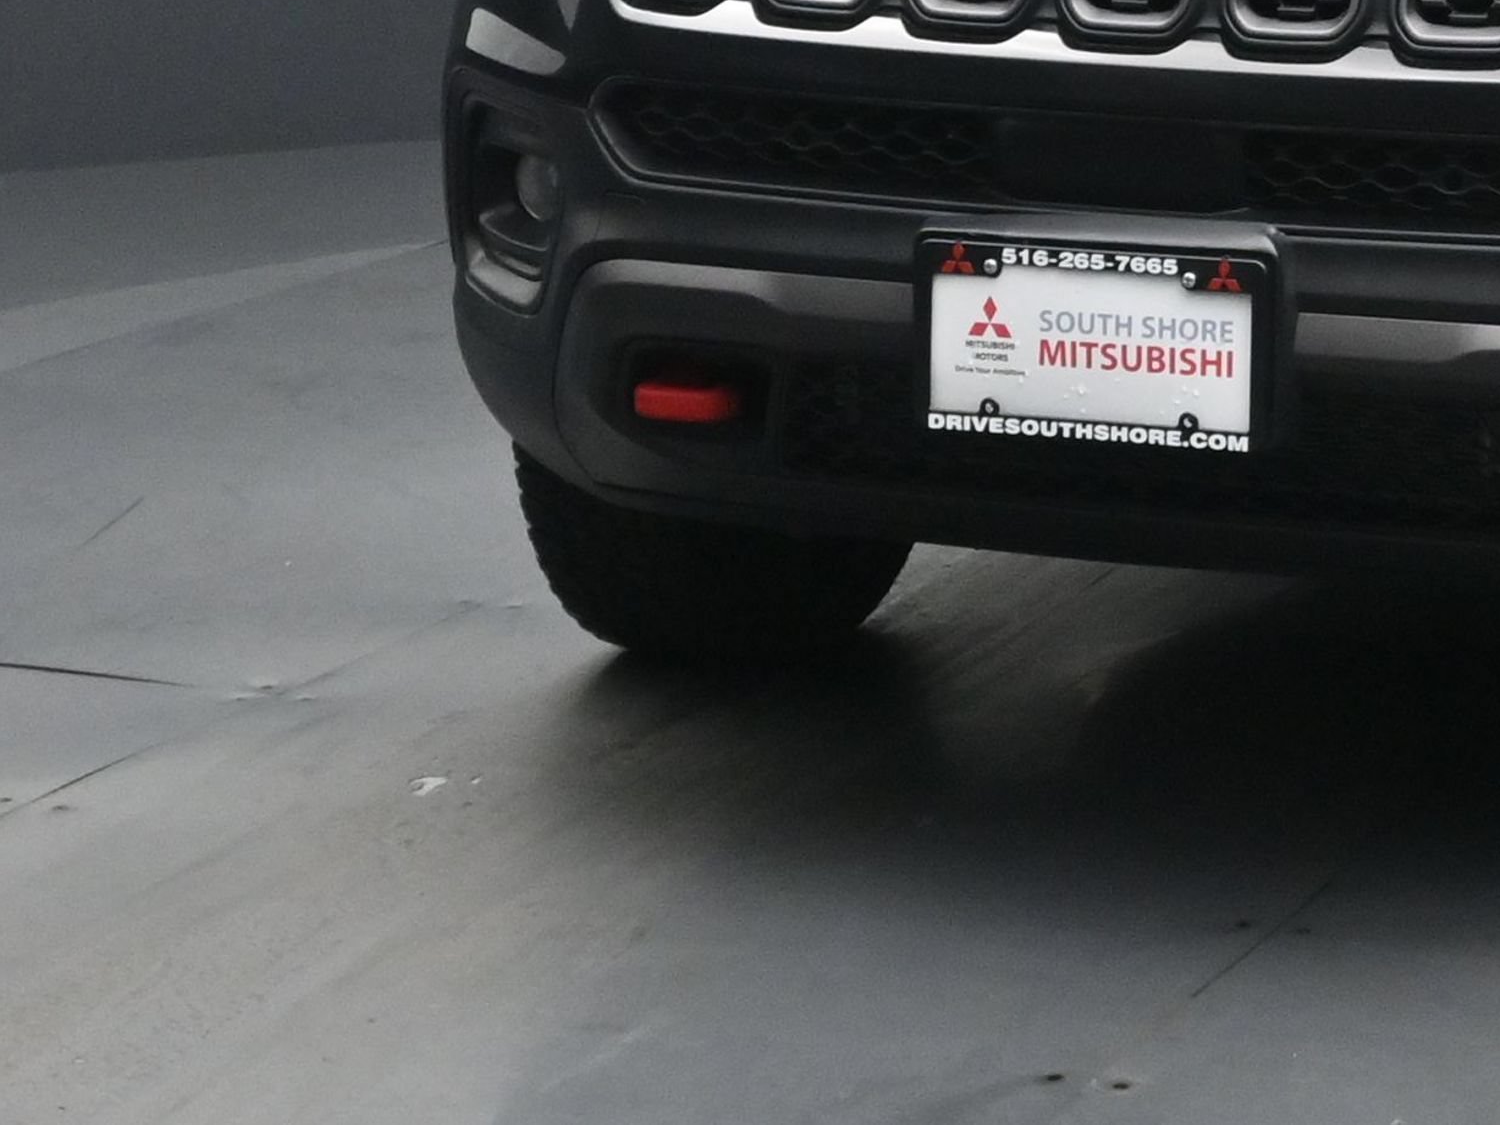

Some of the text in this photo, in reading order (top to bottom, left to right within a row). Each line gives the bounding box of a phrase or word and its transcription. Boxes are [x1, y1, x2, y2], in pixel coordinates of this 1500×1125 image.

[1001, 248, 1179, 275] 516-265-7665
[1038, 310, 1234, 343] SOUTH SHORE
[965, 340, 1016, 350] MITSUBISHI
[1038, 339, 1234, 378] MITSUBISHI
[928, 413, 1249, 452] DRIVESOUTHSHORE.COM
